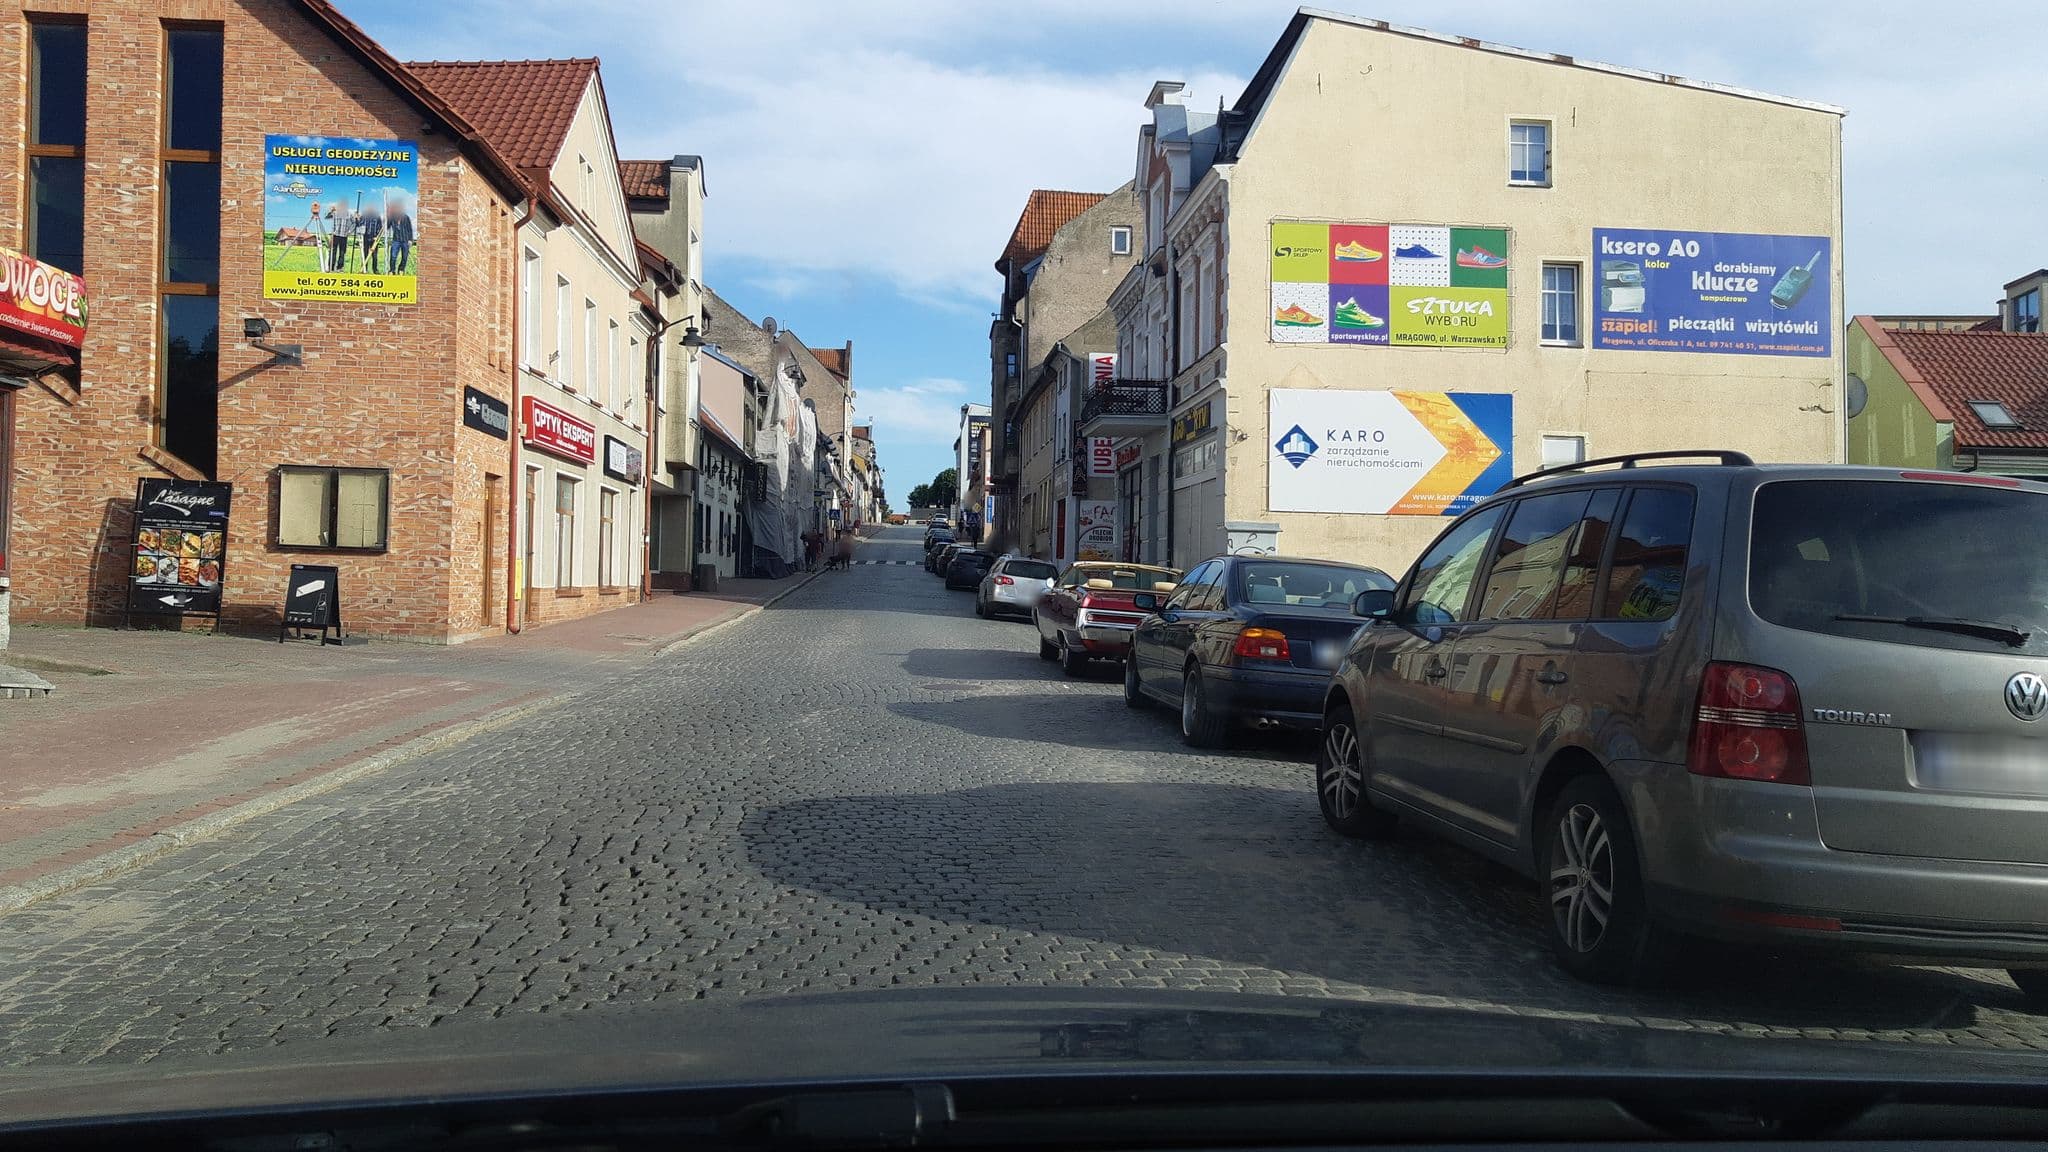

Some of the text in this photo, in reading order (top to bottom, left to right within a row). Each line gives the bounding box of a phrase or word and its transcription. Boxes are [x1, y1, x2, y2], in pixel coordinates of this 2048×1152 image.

[273, 147, 410, 162] USŁUGI GEODEZYJNE
[285, 164, 398, 178] NIERUCHOMOŚCI
[1601, 236, 1660, 256] ksero
[1645, 258, 1671, 269] kolor
[1714, 261, 1777, 277] dorabiamy
[297, 277, 384, 289] tel. 607 584 460
[1691, 271, 1759, 293] klucze
[271, 286, 409, 300] www.januszewski.mazury.pl
[1701, 294, 1748, 304] komputerowo
[1406, 297, 1493, 317] SZTUKA
[1424, 314, 1477, 327] WYBORU
[1668, 316, 1735, 333] pieczątki
[1745, 319, 1819, 336] wizytówki
[1330, 332, 1388, 342] sportowysklep.pl
[1395, 333, 1438, 344] MRĄGOWO,
[1440, 334, 1450, 343] ul.
[1451, 335, 1496, 344] Warszawska
[534, 407, 563, 436] OPTYK
[562, 422, 595, 449] EKSPERT
[1326, 429, 1385, 443] KARO
[1326, 447, 1390, 458] zarządzanie
[1326, 458, 1423, 469] nieruchomościami
[149, 489, 215, 515] Lasagne
[1813, 708, 1891, 725] TOURAN
